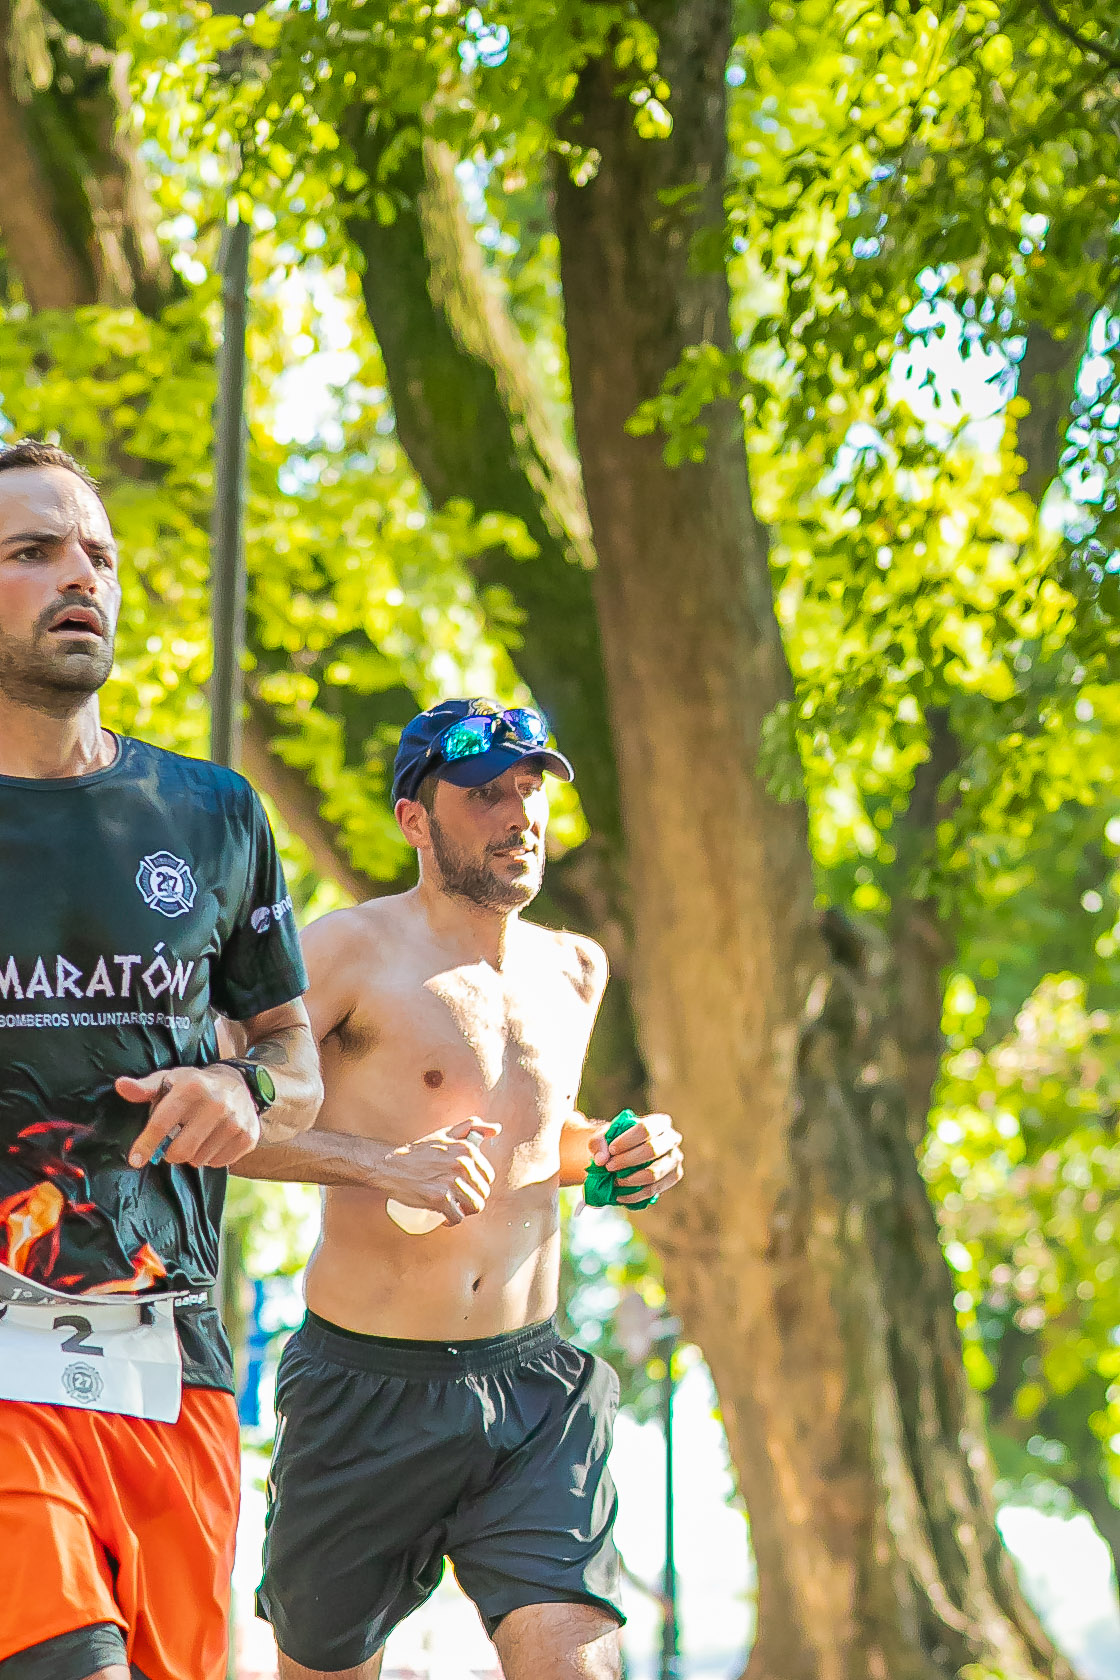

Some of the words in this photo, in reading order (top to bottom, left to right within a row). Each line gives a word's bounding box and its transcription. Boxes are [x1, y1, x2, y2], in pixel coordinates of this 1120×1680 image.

[156, 871, 178, 892] 27
[71, 1012, 155, 1026] VOLUNTAROS
[53, 1315, 104, 1357] 2
